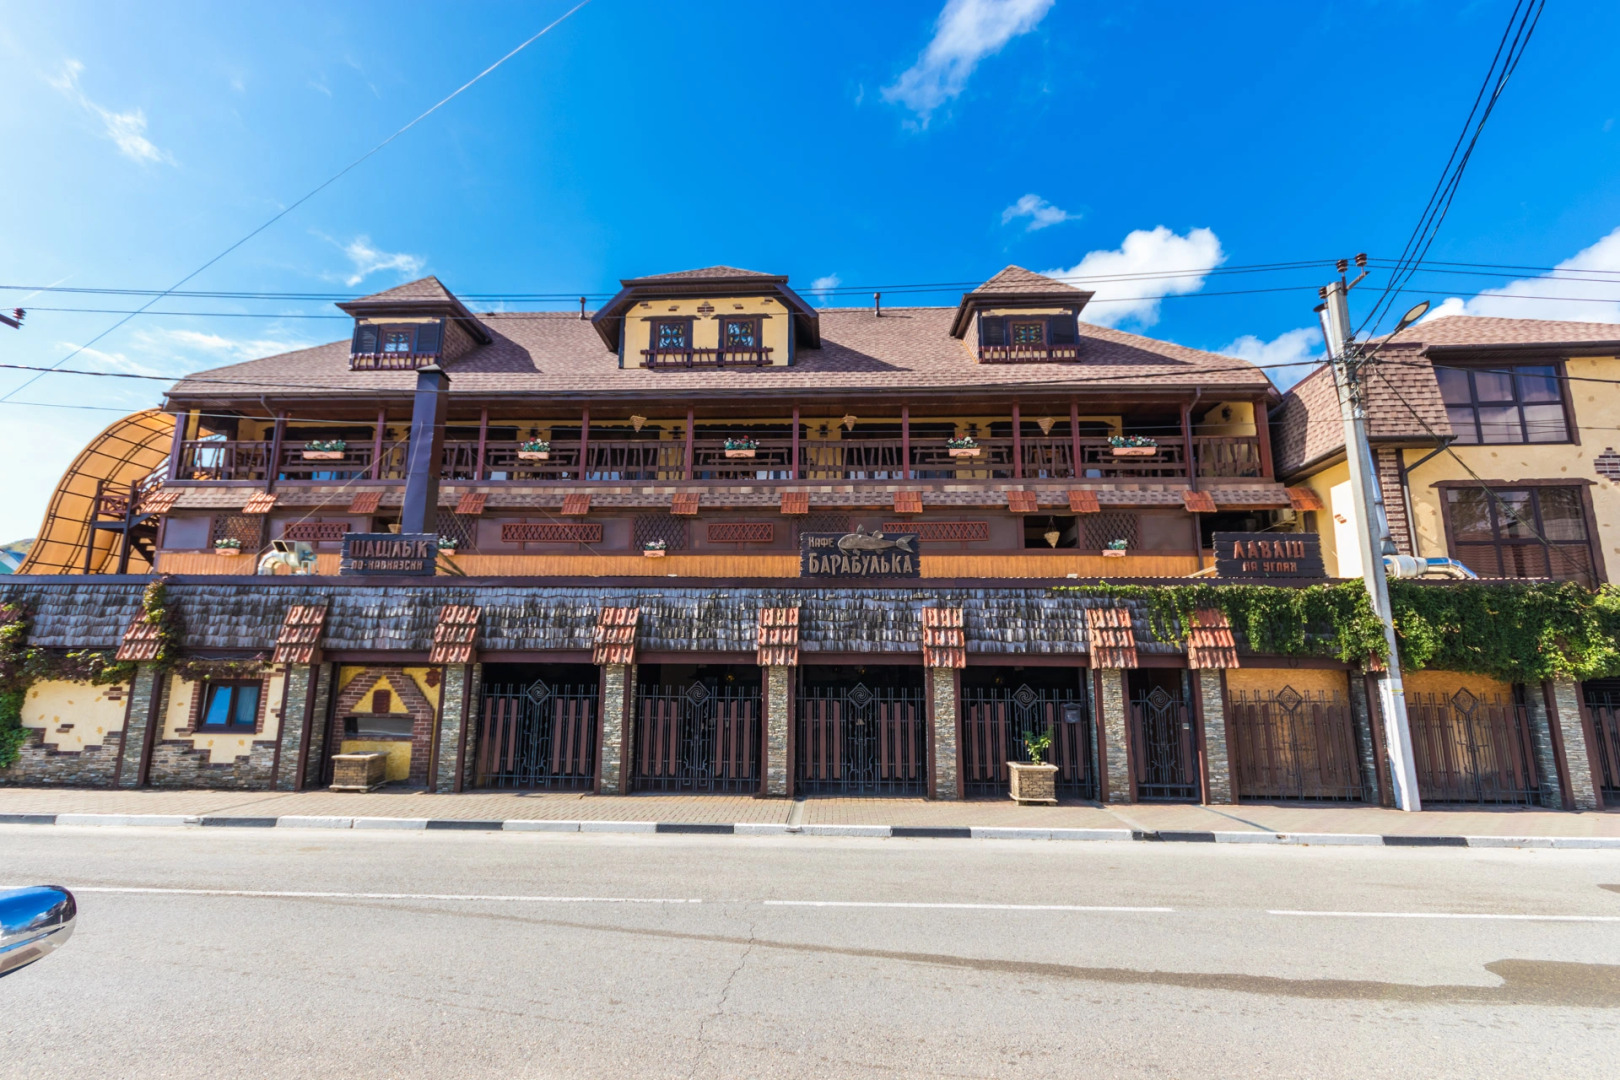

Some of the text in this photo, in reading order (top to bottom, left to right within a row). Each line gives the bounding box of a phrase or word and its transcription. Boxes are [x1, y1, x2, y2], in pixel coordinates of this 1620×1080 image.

[808, 536, 834, 548] КАФЕ
[1233, 540, 1305, 559] ЛАВАШ
[809, 552, 913, 576] БАРАБУЛЬКА
[1242, 561, 1297, 572] НА УГЛЯХ
